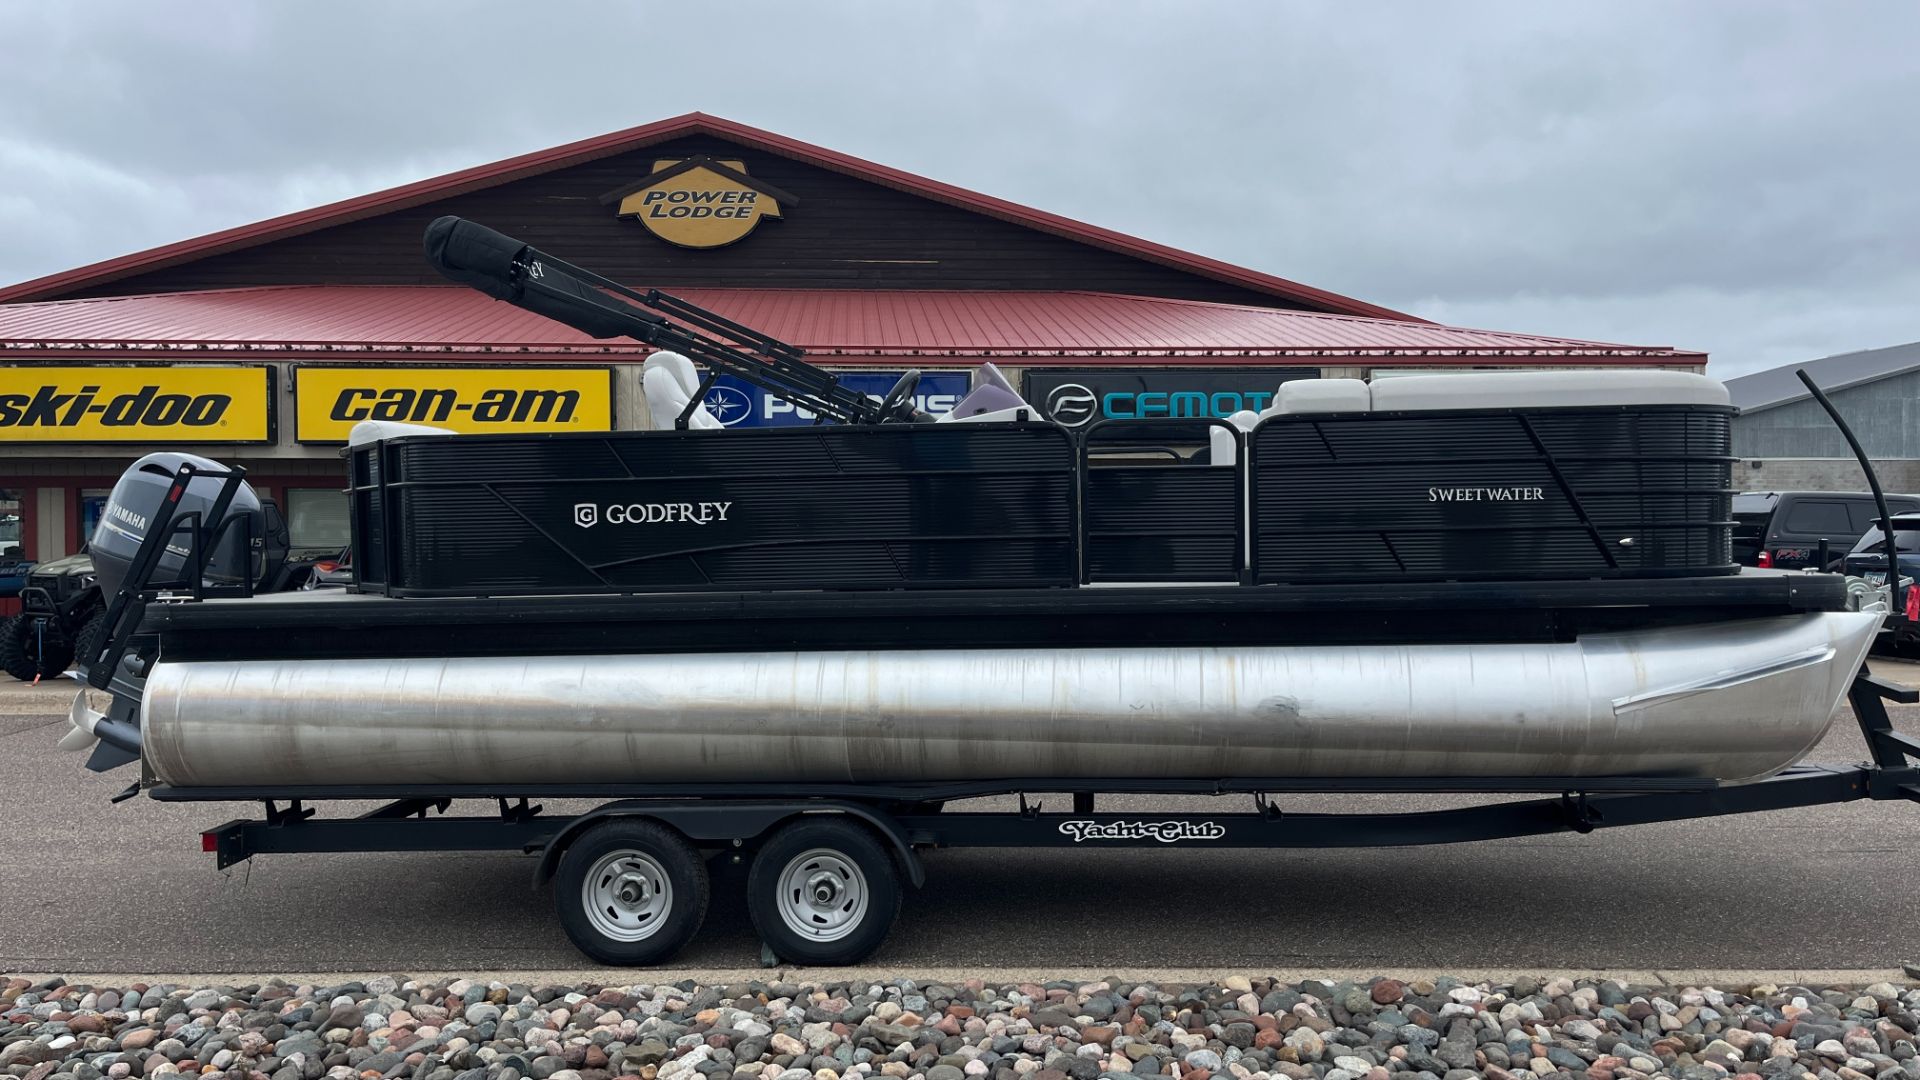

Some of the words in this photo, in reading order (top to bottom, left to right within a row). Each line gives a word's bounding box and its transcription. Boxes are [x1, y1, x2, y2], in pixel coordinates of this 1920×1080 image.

[643, 191, 757, 206] POWER
[649, 204, 753, 219] LODGE
[0, 386, 232, 427] ski-doo
[330, 388, 580, 423] can-am
[1103, 391, 1272, 418] CFMOT
[1428, 487, 1545, 502] SWEETWATER
[112, 504, 146, 531] YAMAHA
[606, 502, 732, 525] GODFREY
